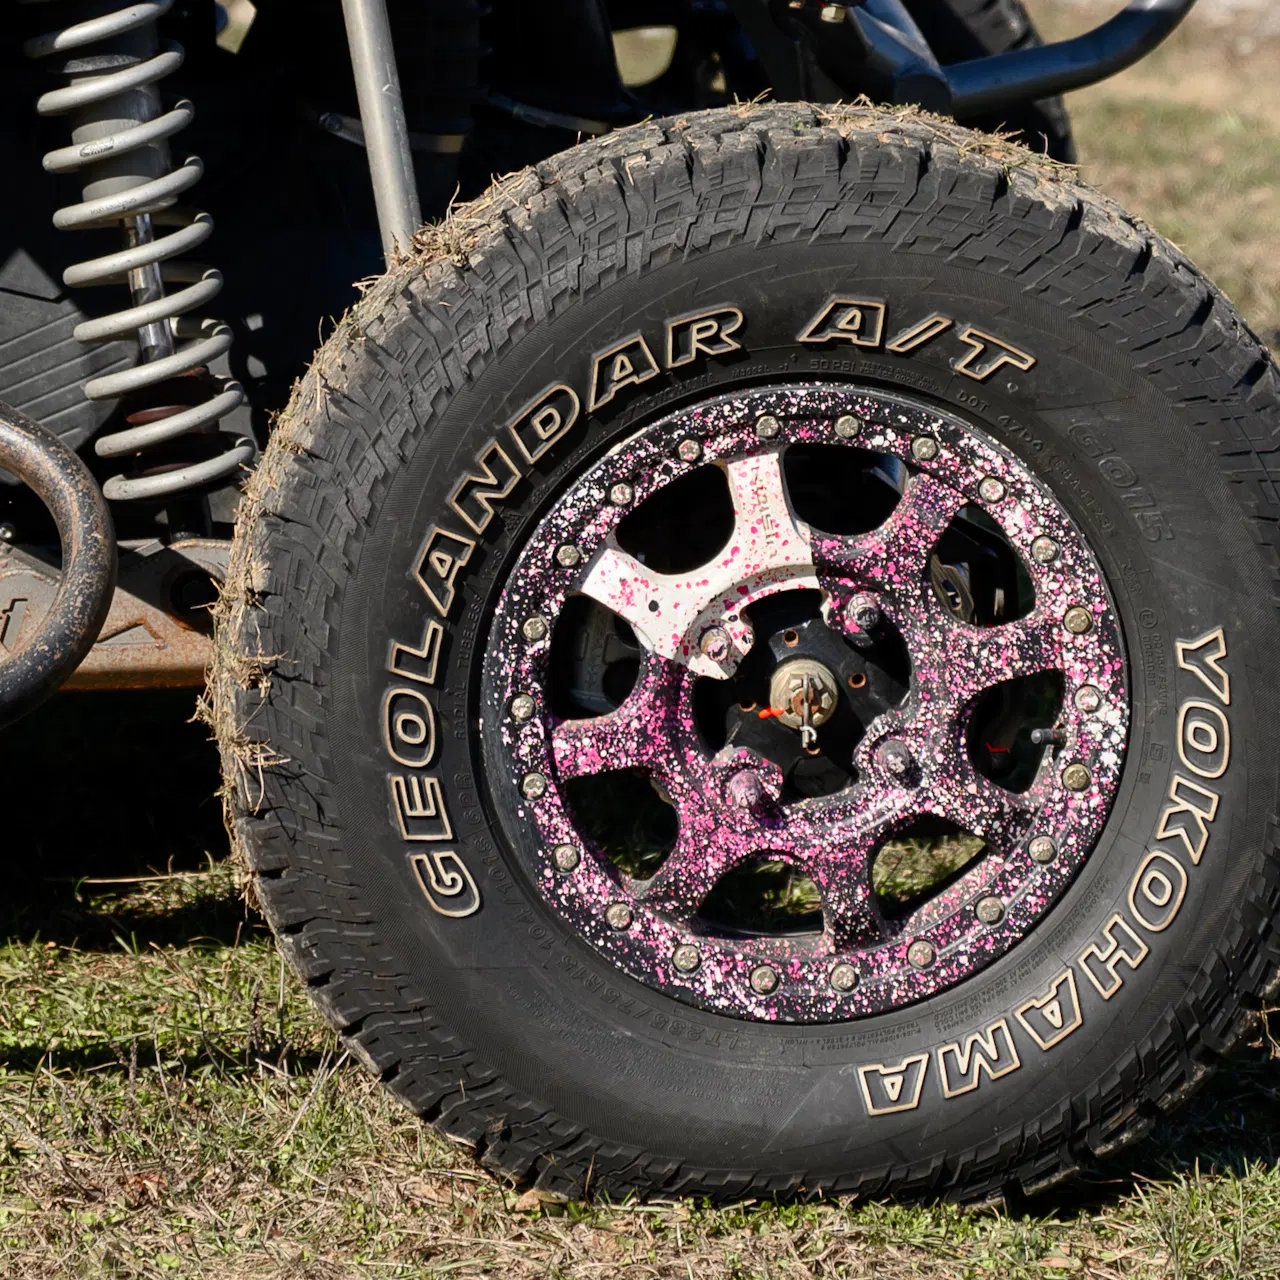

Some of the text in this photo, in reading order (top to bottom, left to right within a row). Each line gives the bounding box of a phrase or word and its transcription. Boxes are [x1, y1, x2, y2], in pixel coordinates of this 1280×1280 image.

[953, 385, 992, 415] DOT
[382, 293, 1037, 919] GEOLANDAR A/T
[455, 591, 485, 670] TUBELESS
[856, 627, 1232, 1116] YOKOHAMA
